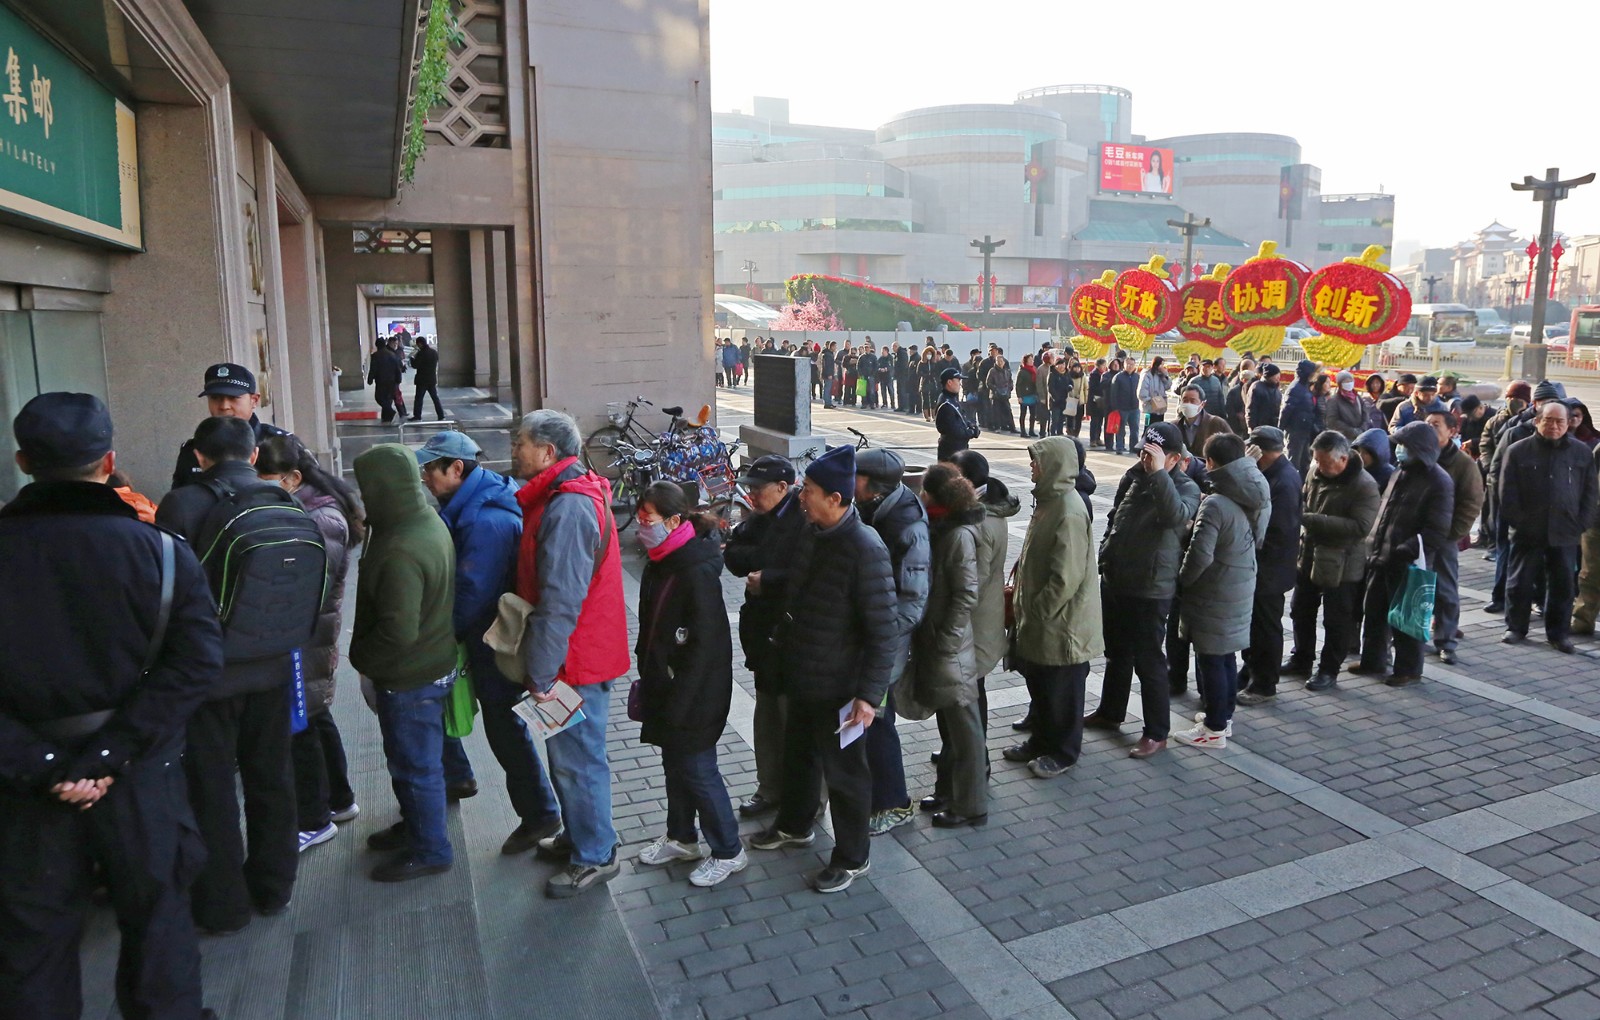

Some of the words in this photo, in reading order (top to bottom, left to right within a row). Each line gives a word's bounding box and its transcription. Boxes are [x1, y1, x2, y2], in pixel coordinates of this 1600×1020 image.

[2, 46, 54, 139] 集邮
[1077, 296, 1111, 328] 共享
[1121, 284, 1158, 321] 开放
[1183, 297, 1227, 330] 绿色
[1232, 280, 1287, 313] 协调
[1315, 284, 1380, 329] 创新
